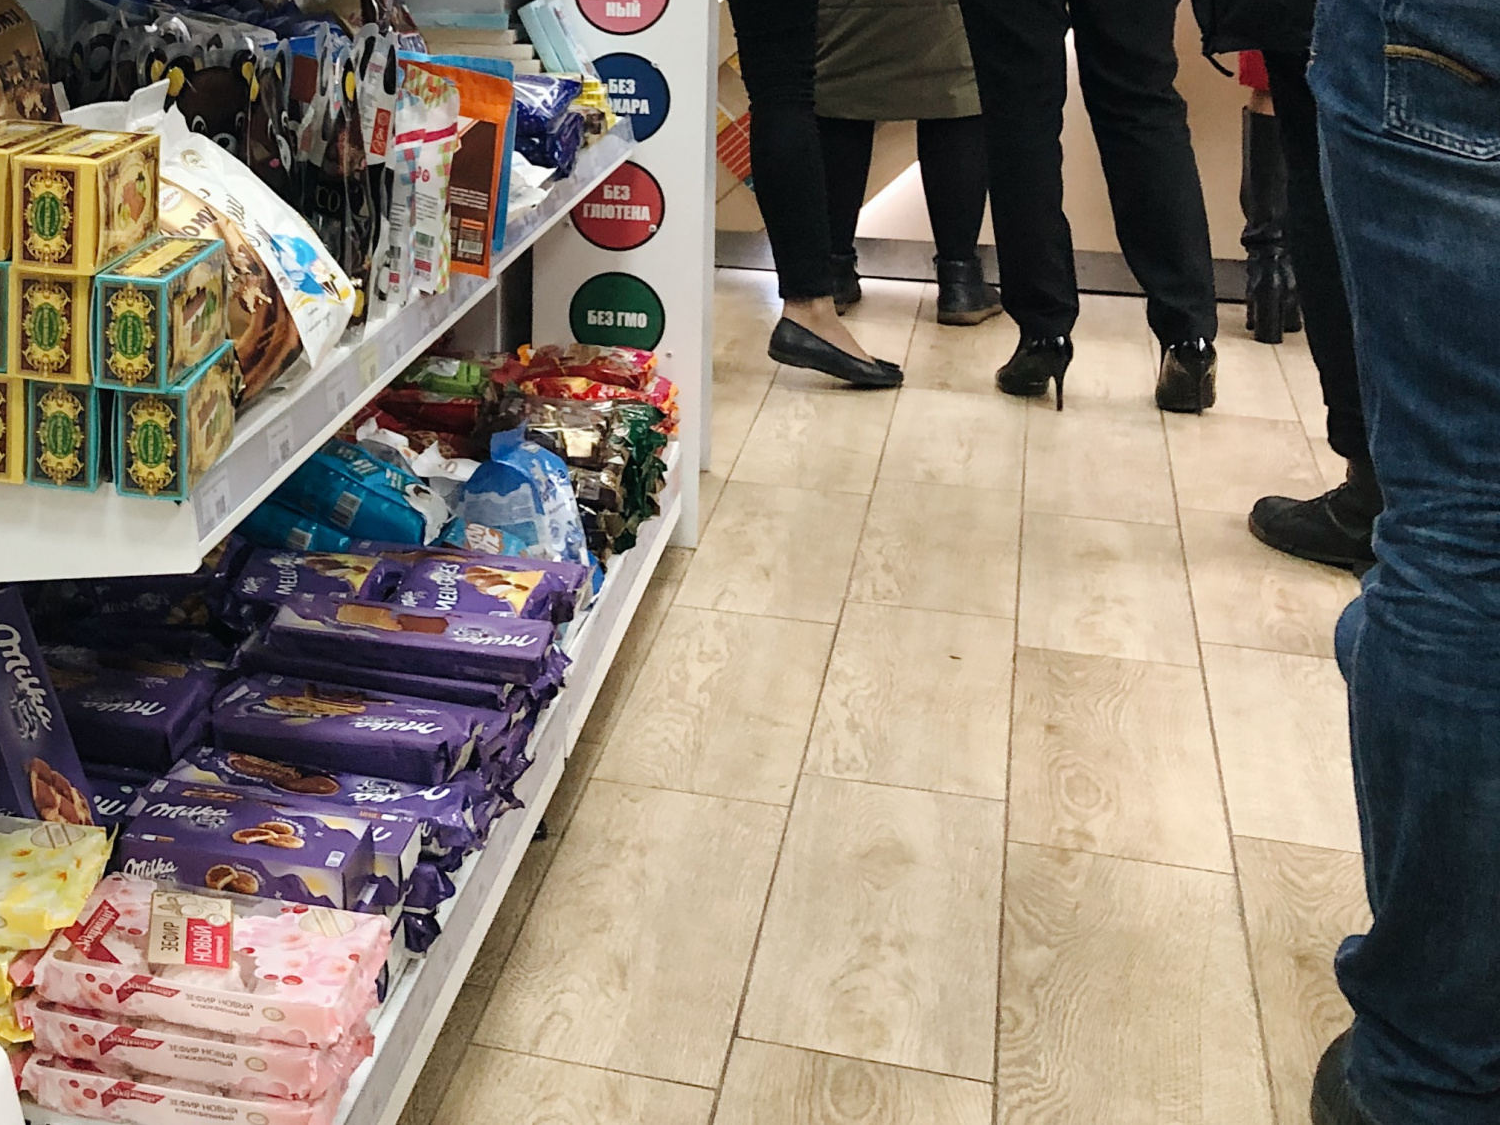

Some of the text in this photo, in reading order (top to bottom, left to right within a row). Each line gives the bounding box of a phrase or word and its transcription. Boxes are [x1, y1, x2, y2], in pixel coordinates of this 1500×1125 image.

[605, 0, 641, 18] НЫЙ
[608, 78, 636, 95] БЕЗ
[603, 184, 631, 201] БЕЗ
[582, 203, 651, 221] ГЛЮТЕНА
[587, 309, 648, 328] БЕЗ ГМО
[145, 801, 233, 818] Milka
[123, 856, 179, 877] Milka
[160, 921, 181, 952] ЗЕФИР
[190, 924, 213, 963] НОВЫЙ
[185, 993, 254, 1011] ЗЕФИР НОВЫЙ
[168, 1044, 238, 1061] ЗЕФИР НОВЫЙ
[202, 1103, 239, 1115] НОВЫЙ
